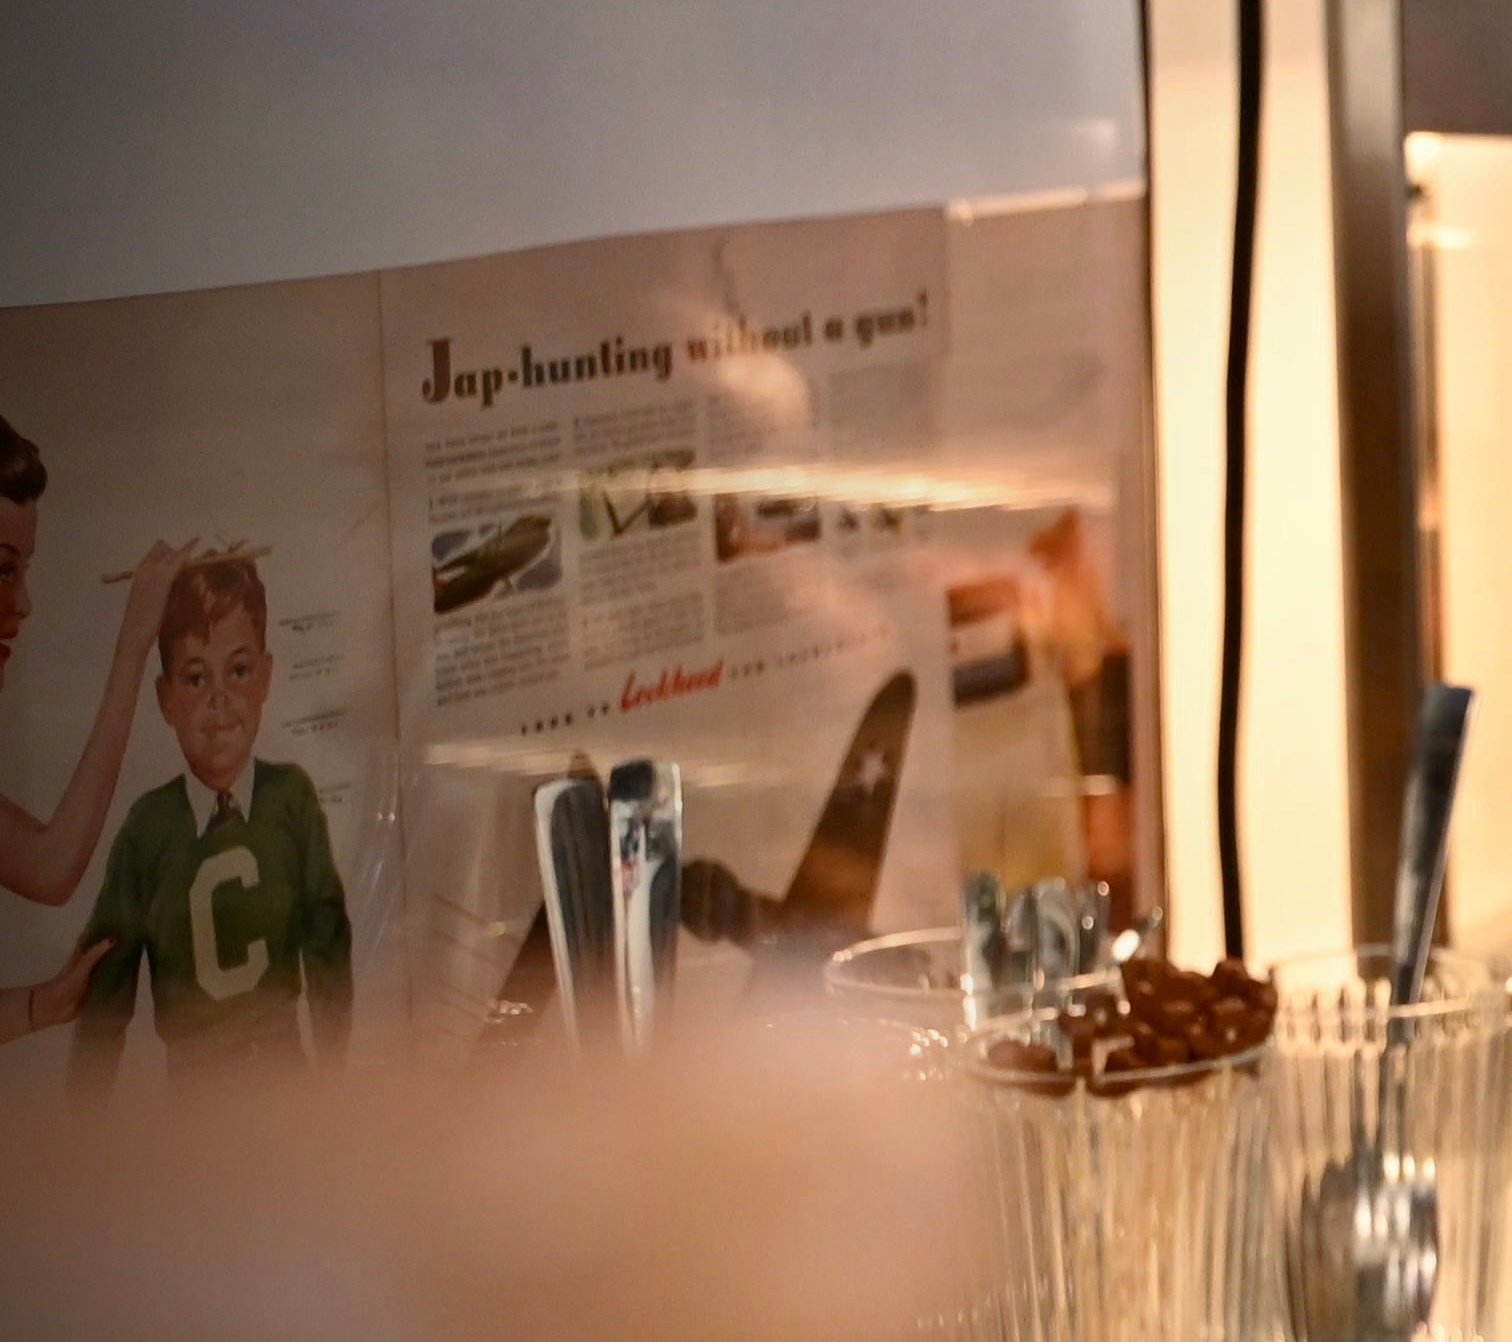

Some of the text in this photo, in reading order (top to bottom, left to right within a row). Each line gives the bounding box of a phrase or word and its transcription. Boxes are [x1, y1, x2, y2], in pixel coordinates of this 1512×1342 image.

[686, 309, 813, 363] without
[824, 322, 843, 342] a
[189, 846, 270, 1002] C
